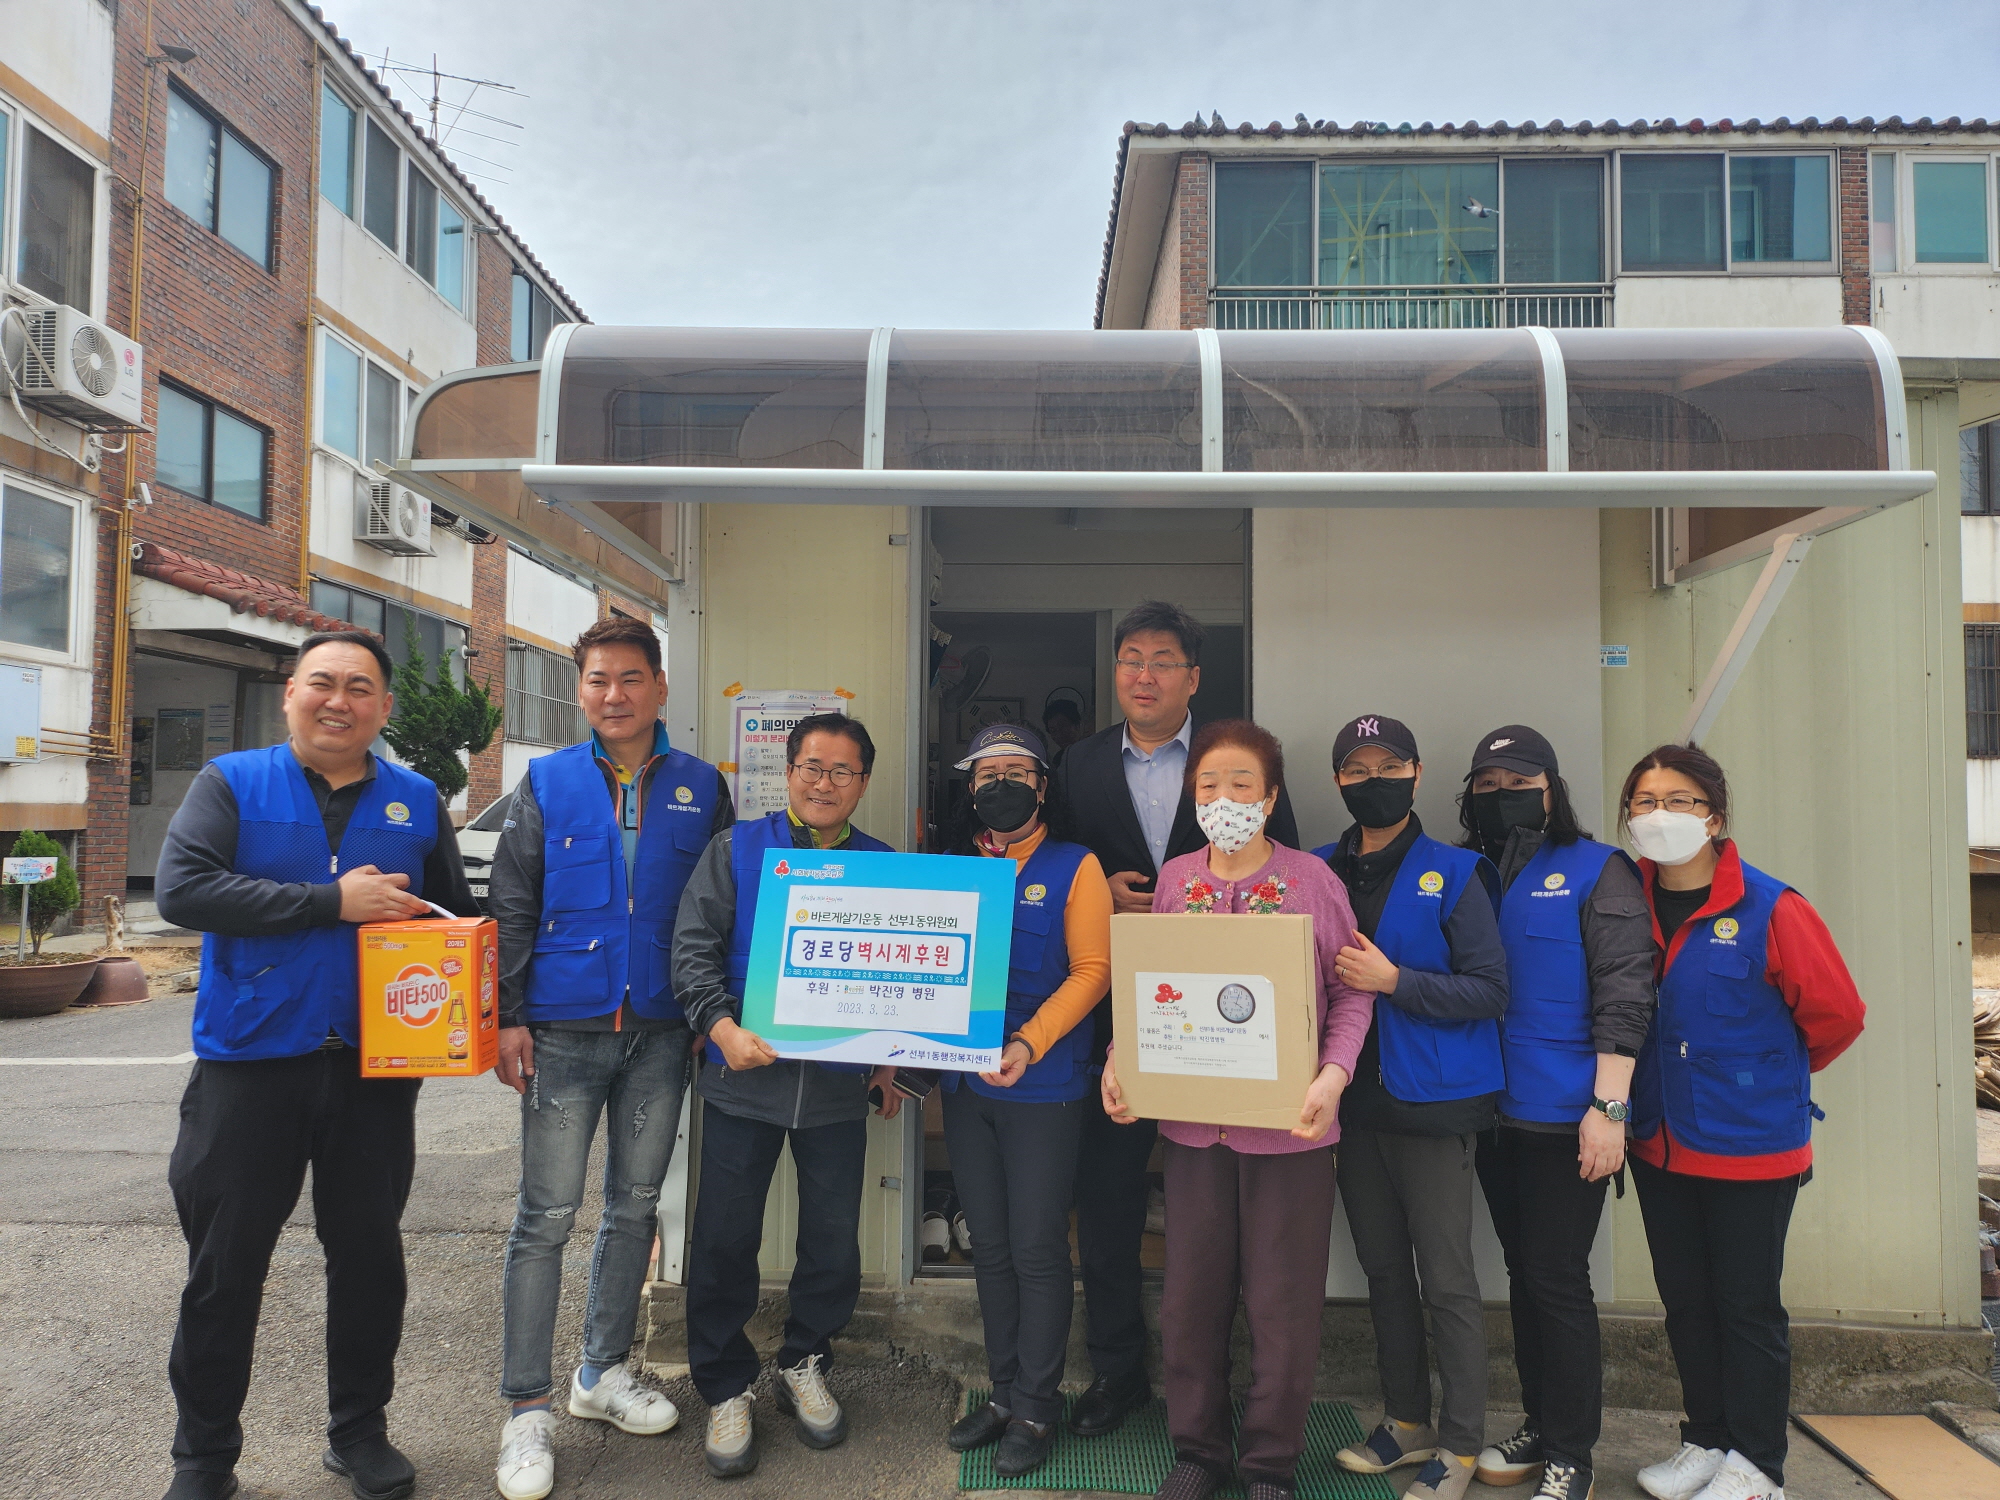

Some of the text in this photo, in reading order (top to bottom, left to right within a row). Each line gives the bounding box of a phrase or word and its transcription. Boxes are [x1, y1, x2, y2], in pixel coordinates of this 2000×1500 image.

[124, 366, 134, 377] LG
[761, 719, 801, 731] 폐의약
[1357, 717, 1380, 738] NY
[745, 734, 768, 743] 이렇게
[811, 911, 958, 929] 바르게살기운동 선부1동위원회
[383, 942, 403, 950] 500mg
[387, 981, 448, 1016] 비타500
[806, 981, 829, 995] 후원
[869, 984, 904, 999] 박진영
[912, 987, 935, 1001] 병원
[837, 1002, 899, 1016] 2023. 3. 23.
[909, 1049, 992, 1065] 선부1동행정복지센터
